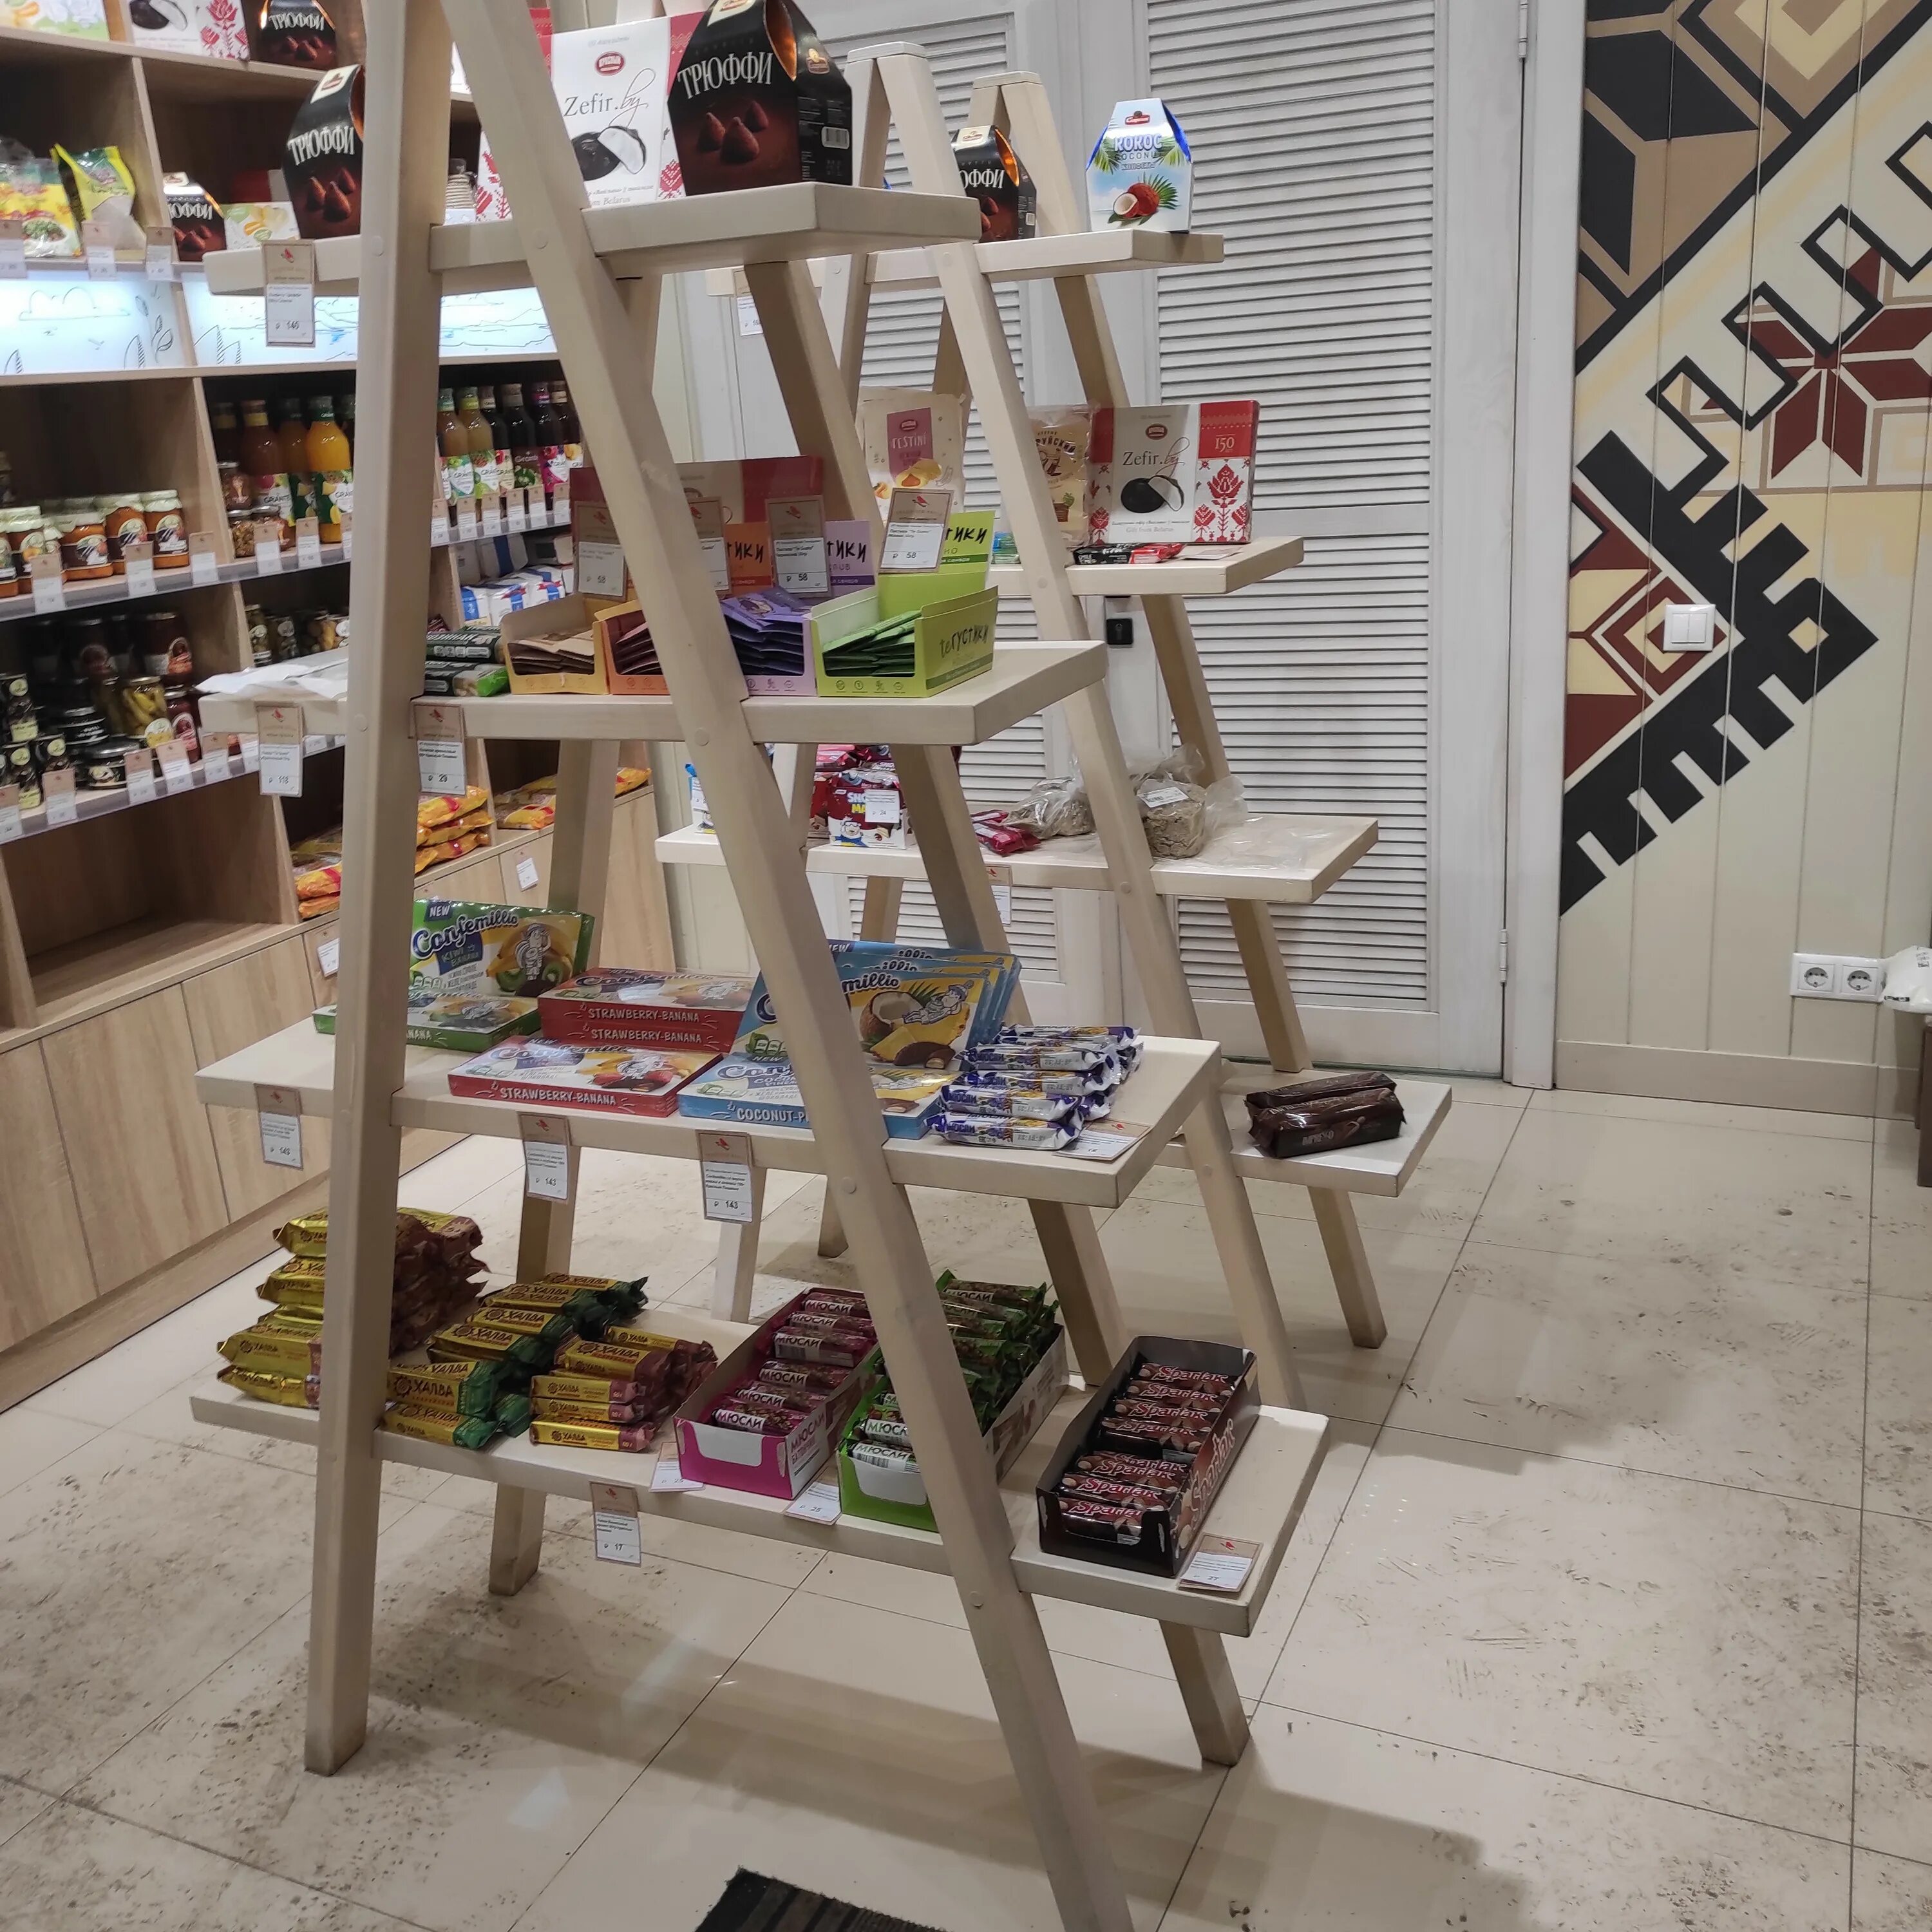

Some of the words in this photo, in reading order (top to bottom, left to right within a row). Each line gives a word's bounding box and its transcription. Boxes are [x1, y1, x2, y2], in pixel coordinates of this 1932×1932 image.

[269, 12, 325, 31] ТРЮФФИ
[677, 52, 773, 99] ТРЮФФИ
[287, 125, 355, 166] ТРЮФФИ
[1215, 437, 1235, 453] 150
[429, 905, 451, 918] NEW
[841, 971, 900, 995] millio
[587, 1008, 700, 1023] STRAWBERRY-BANANA
[591, 1028, 703, 1044] STRAWBERRY-BANANA
[500, 1086, 617, 1106] STRAWBERRY-BANANA
[725, 1200, 739, 1209] 143
[806, 1300, 850, 1314] МЮСЛИ
[507, 1310, 545, 1322] ХАЛВА
[792, 1314, 835, 1326] МЮСЛИ
[475, 1327, 514, 1341] ХАЛВА
[775, 1335, 822, 1349] МЮСЛИ
[601, 1345, 640, 1358] ХАЛВА
[431, 1362, 469, 1374] ХАЛВА
[1150, 1365, 1229, 1384] Spartak
[760, 1369, 805, 1384] МЮСЛИ
[412, 1381, 455, 1397] ХАЛВА
[1138, 1382, 1218, 1403] Spartak
[739, 1388, 784, 1407] МЮСЛИ
[717, 1410, 762, 1428] МЮСЛИ
[1127, 1401, 1209, 1421] Spartak
[855, 1444, 909, 1460] МЮСЛИ
[1091, 1459, 1177, 1481] Spartak
[1076, 1477, 1162, 1501] Spartak
